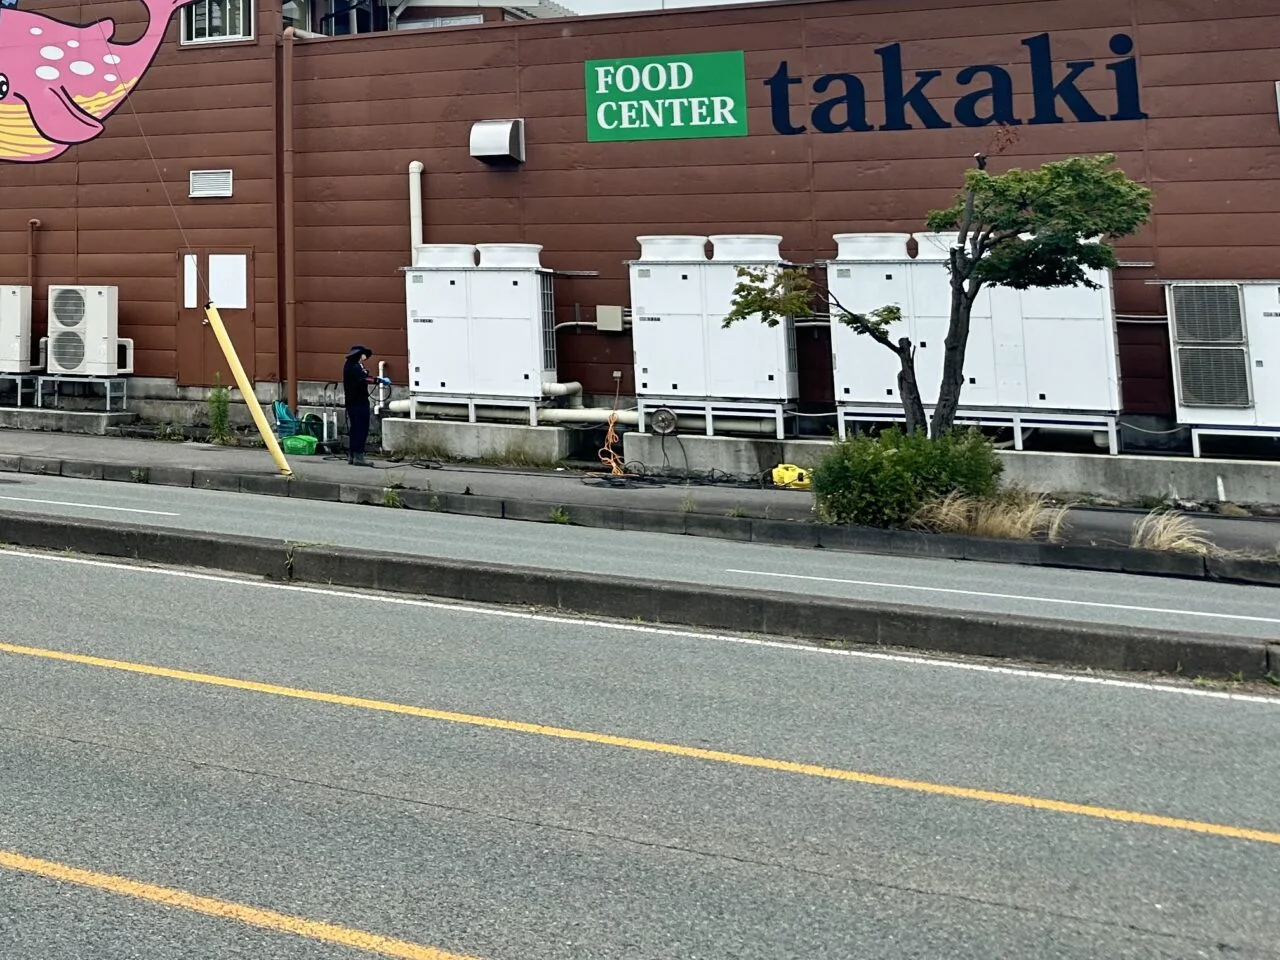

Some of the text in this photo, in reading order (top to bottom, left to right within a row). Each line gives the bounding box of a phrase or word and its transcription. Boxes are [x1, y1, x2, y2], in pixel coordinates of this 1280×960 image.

[595, 62, 693, 94] FOOD
[763, 32, 1148, 136] takaki
[597, 96, 737, 129] CENTER
